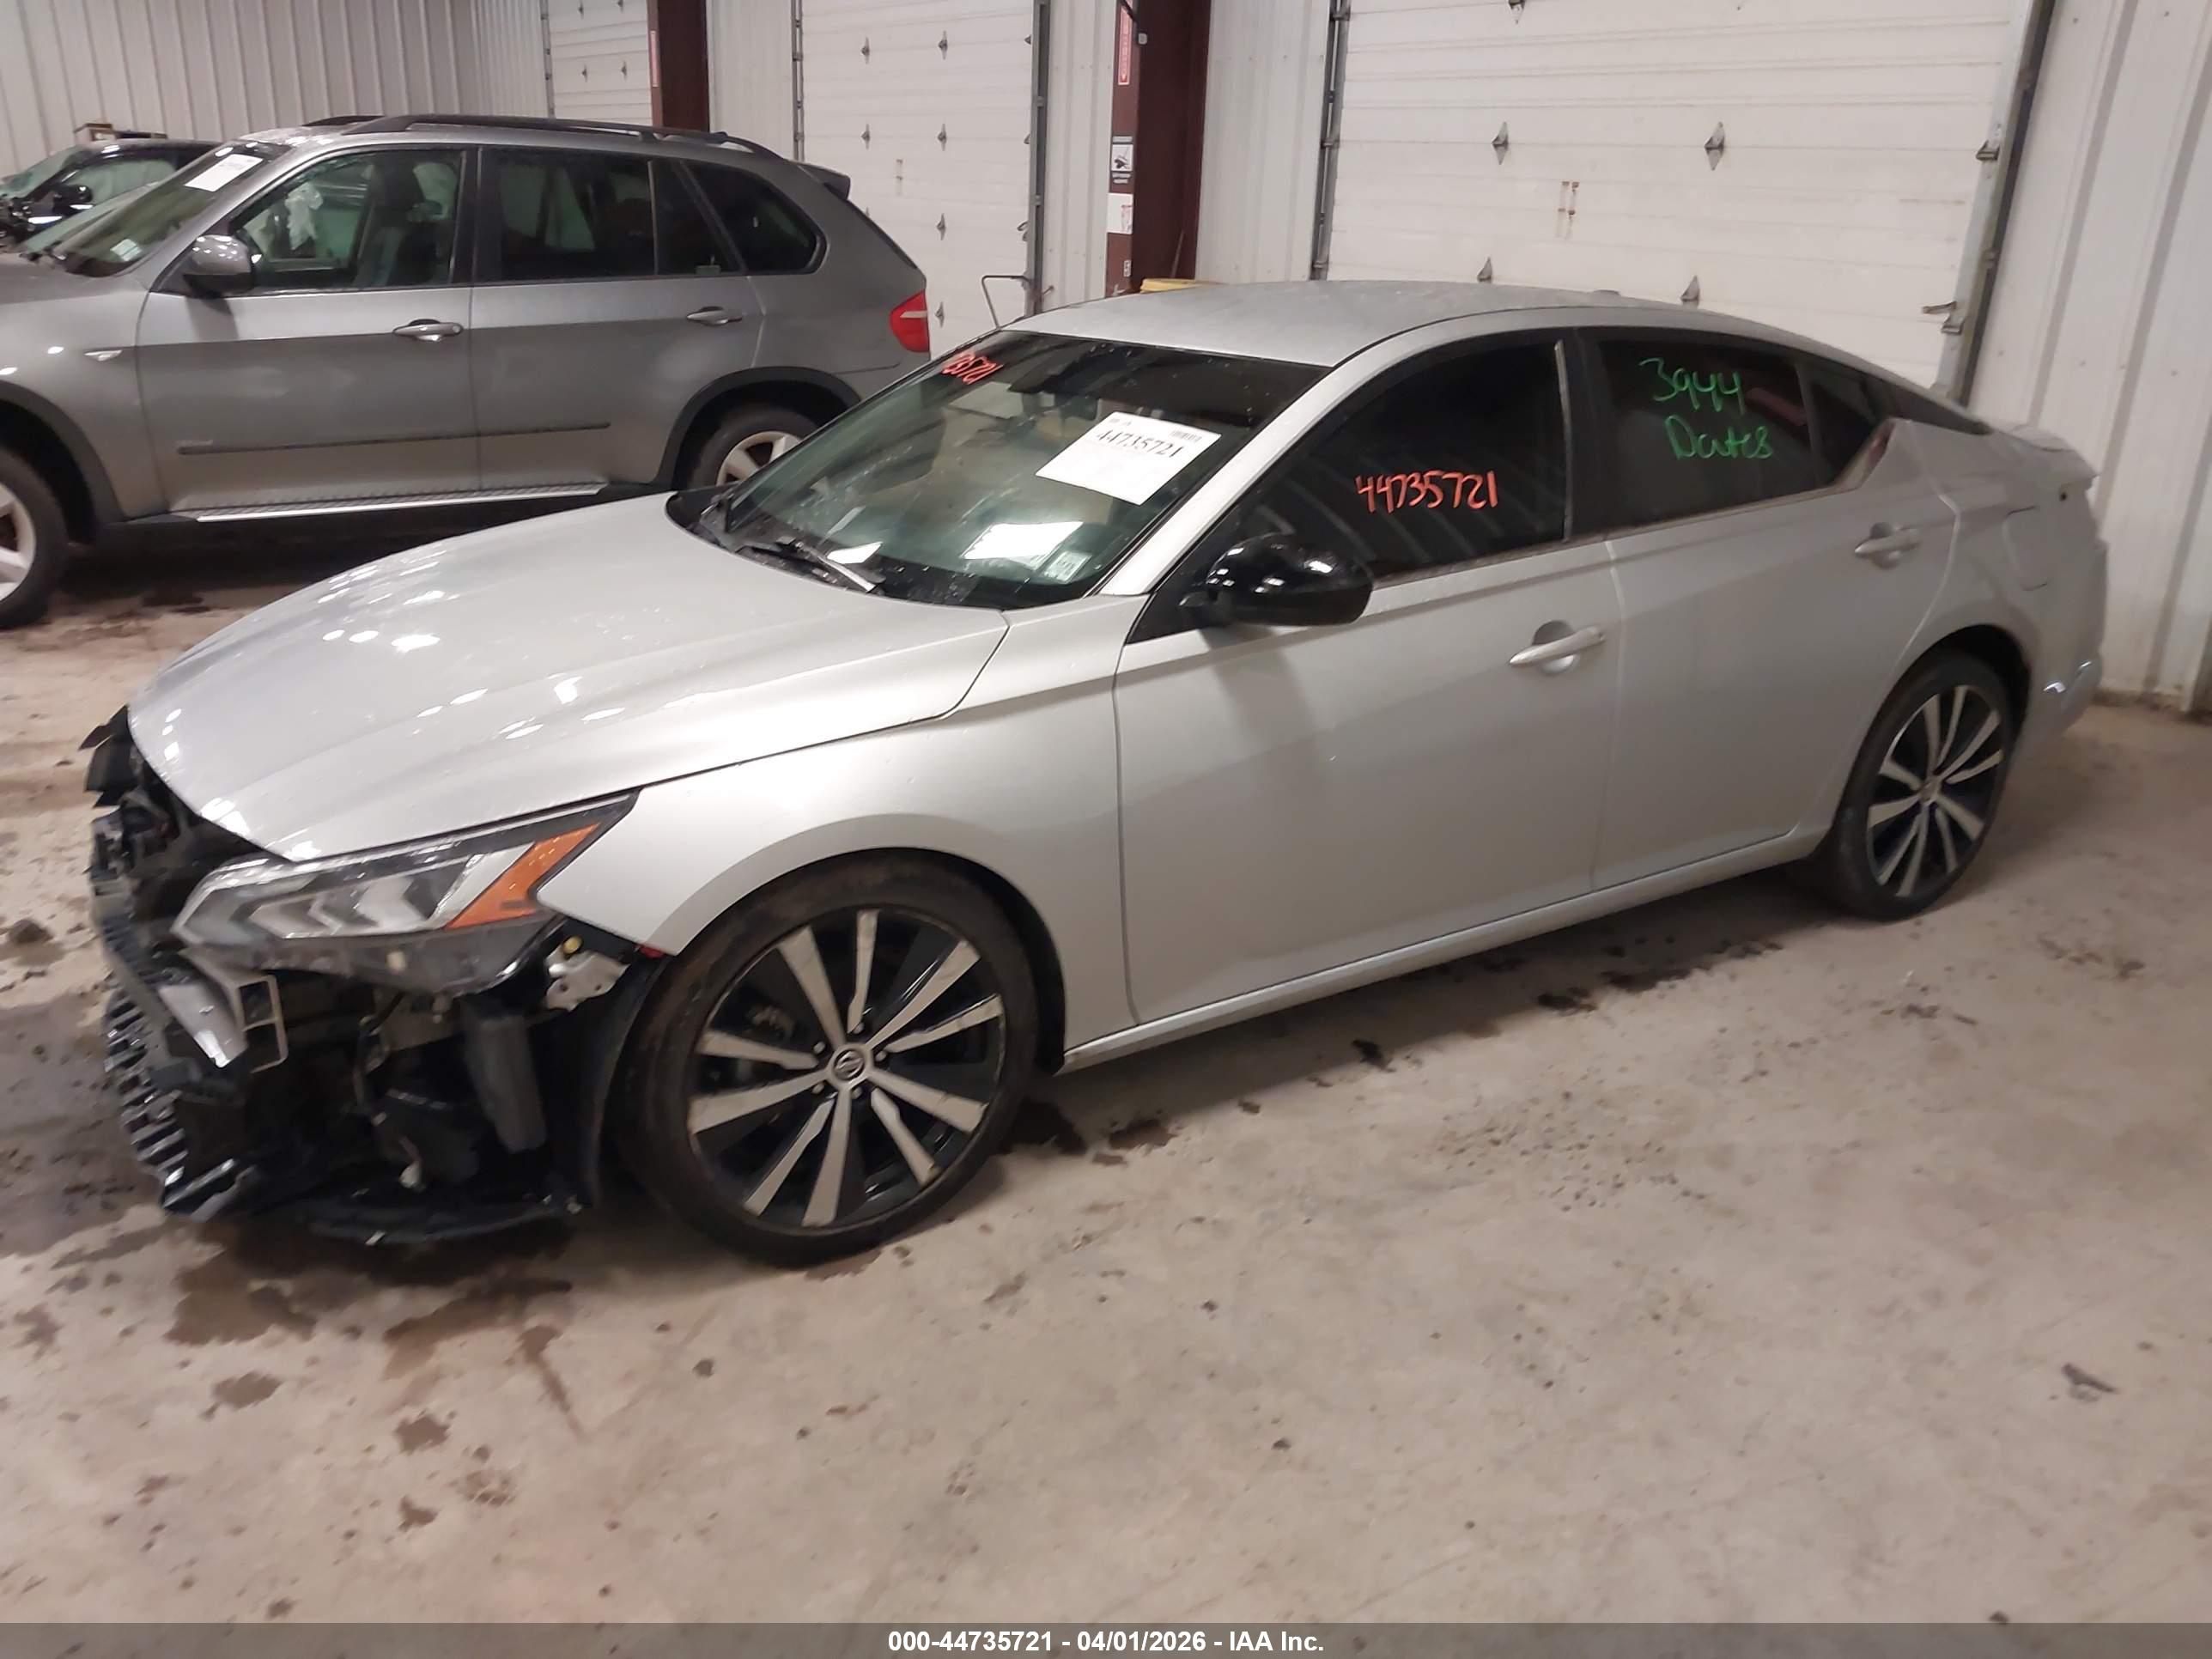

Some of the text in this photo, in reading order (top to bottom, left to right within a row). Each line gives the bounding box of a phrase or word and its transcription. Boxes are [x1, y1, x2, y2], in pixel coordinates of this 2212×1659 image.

[1638, 357, 1745, 415] 3944
[1097, 429, 1184, 458] 44735721
[1355, 470, 1498, 514] 44735721
